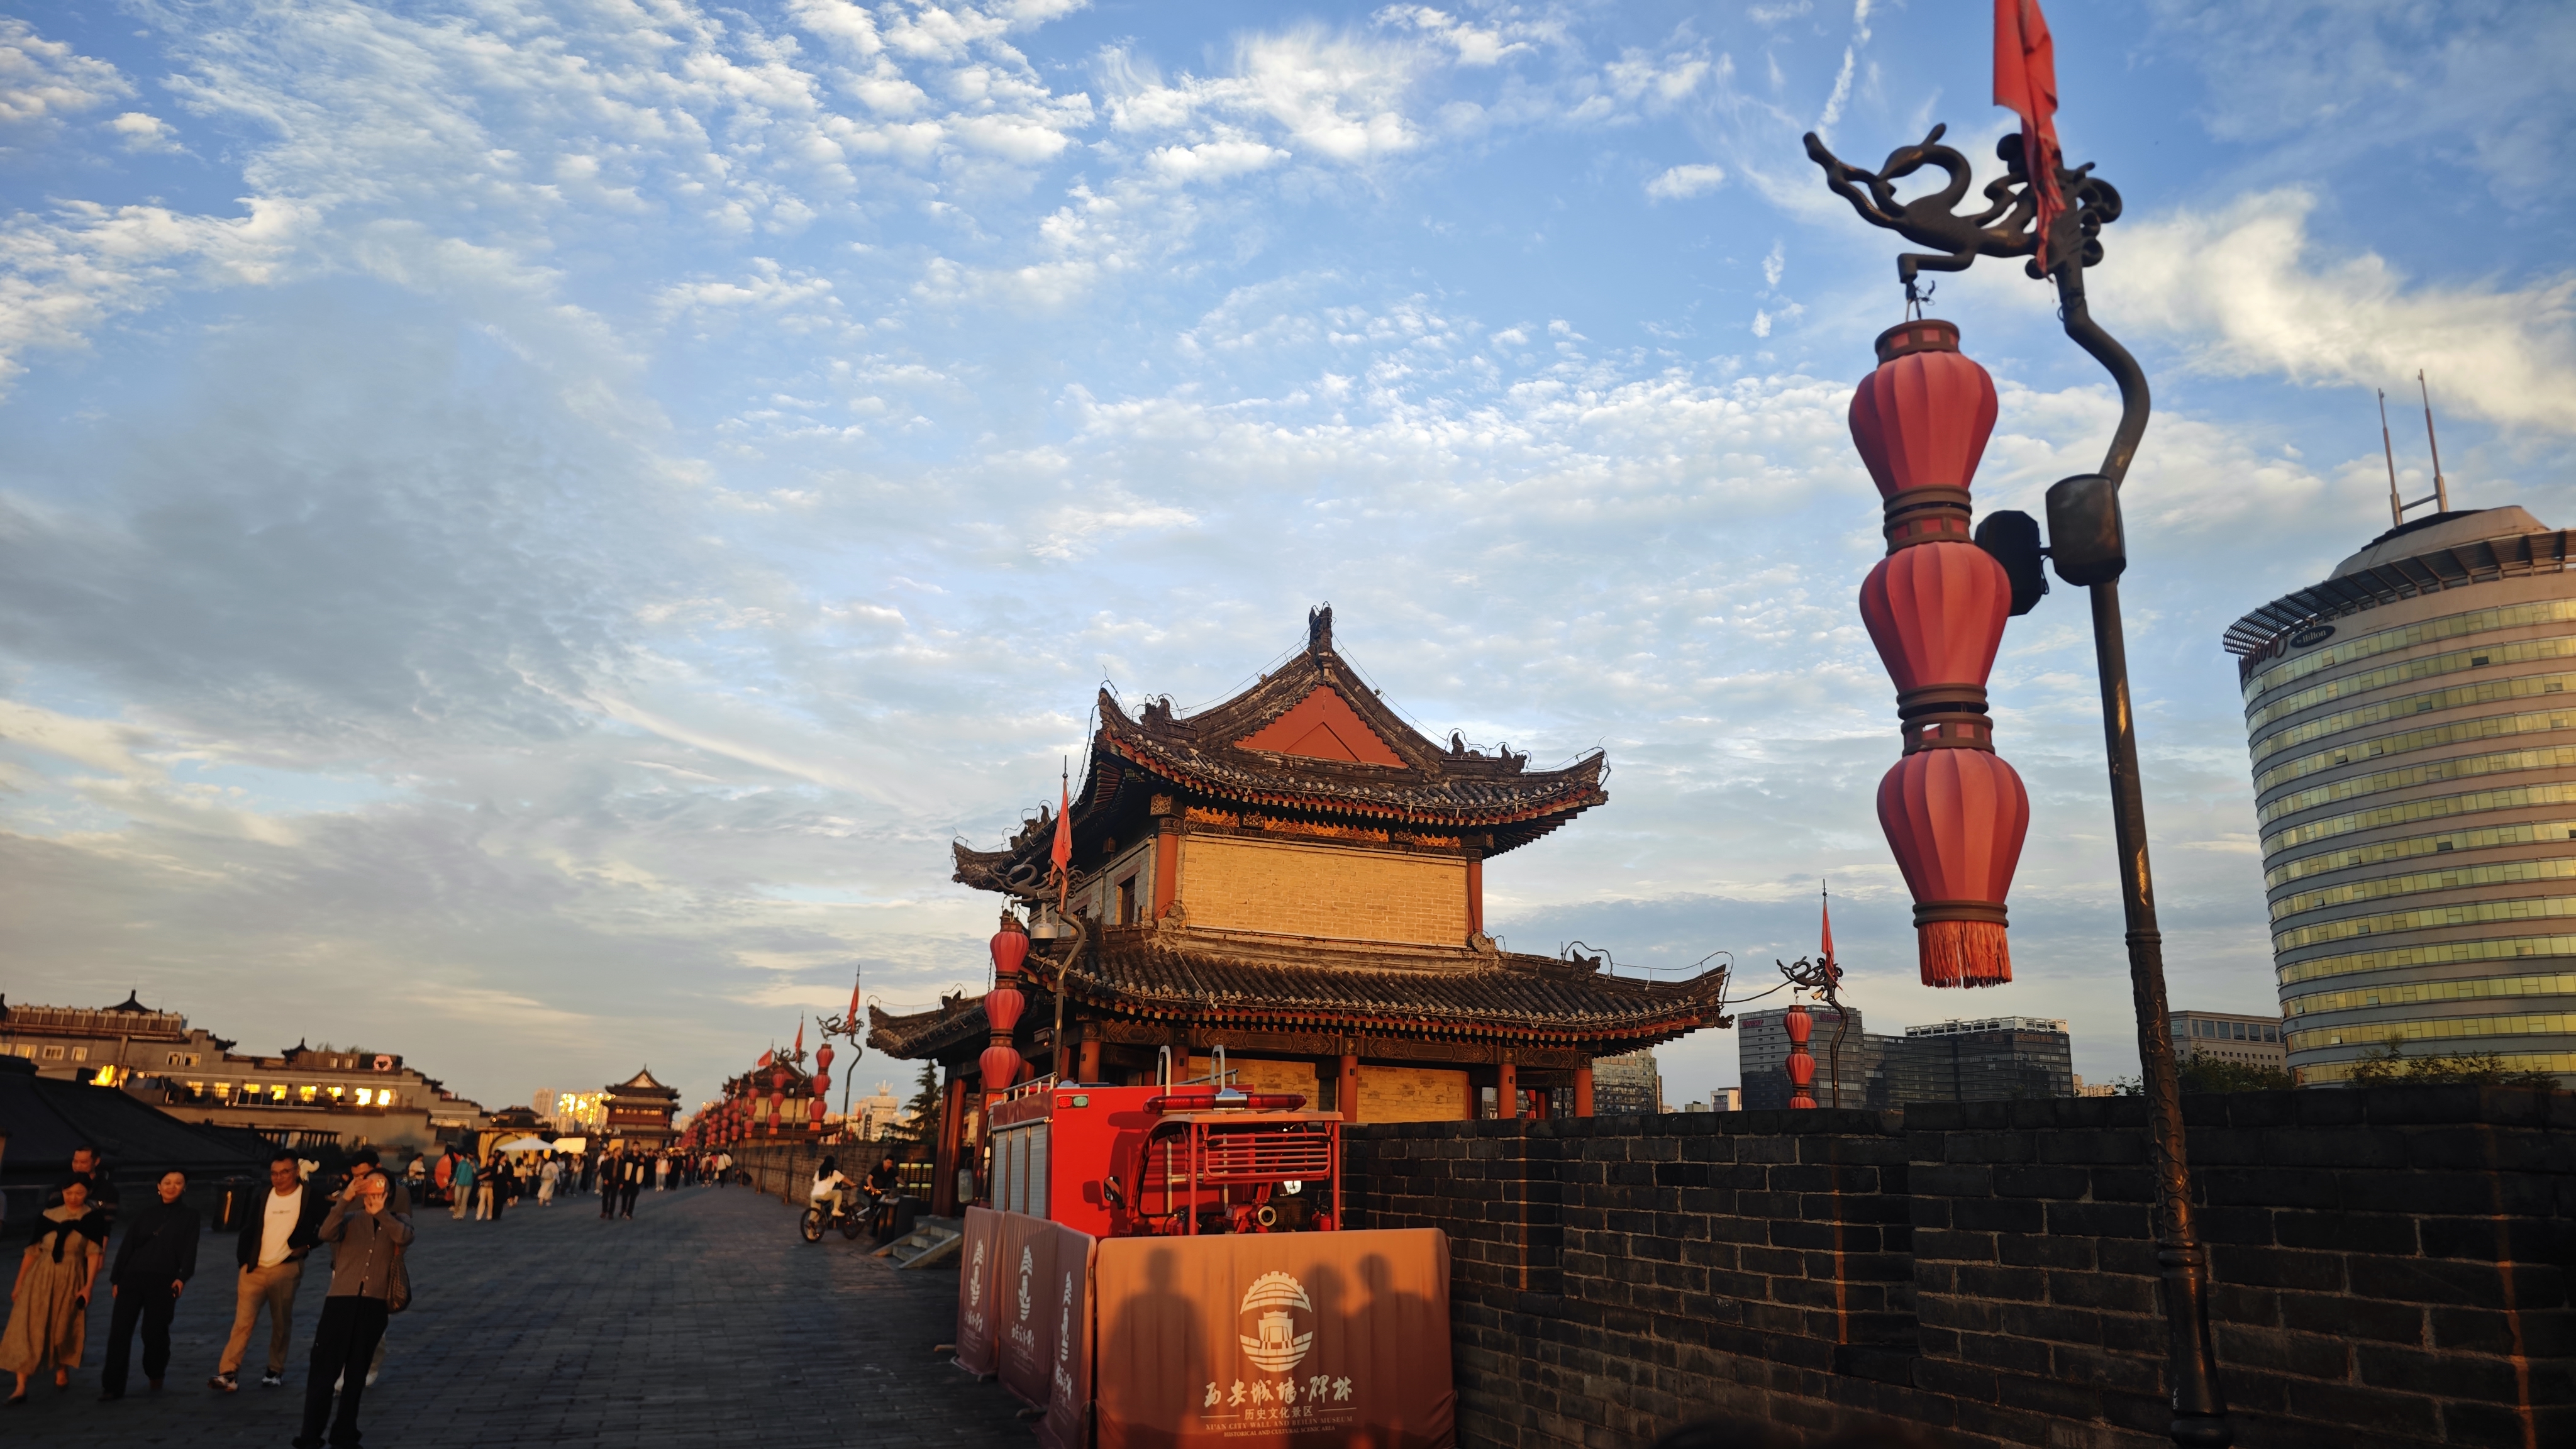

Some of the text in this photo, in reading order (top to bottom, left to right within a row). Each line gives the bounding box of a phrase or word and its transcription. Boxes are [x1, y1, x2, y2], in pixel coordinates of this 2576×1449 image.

[2302, 629, 2326, 643] Hilton
[1204, 1374, 1352, 1408] 西安城墙·碑林
[1244, 1405, 1313, 1420] 历史文化景区
[1250, 1421, 1272, 1429] WALL
[1292, 1418, 1318, 1426] BEILIN
[1320, 1416, 1353, 1424] MUSEUM
